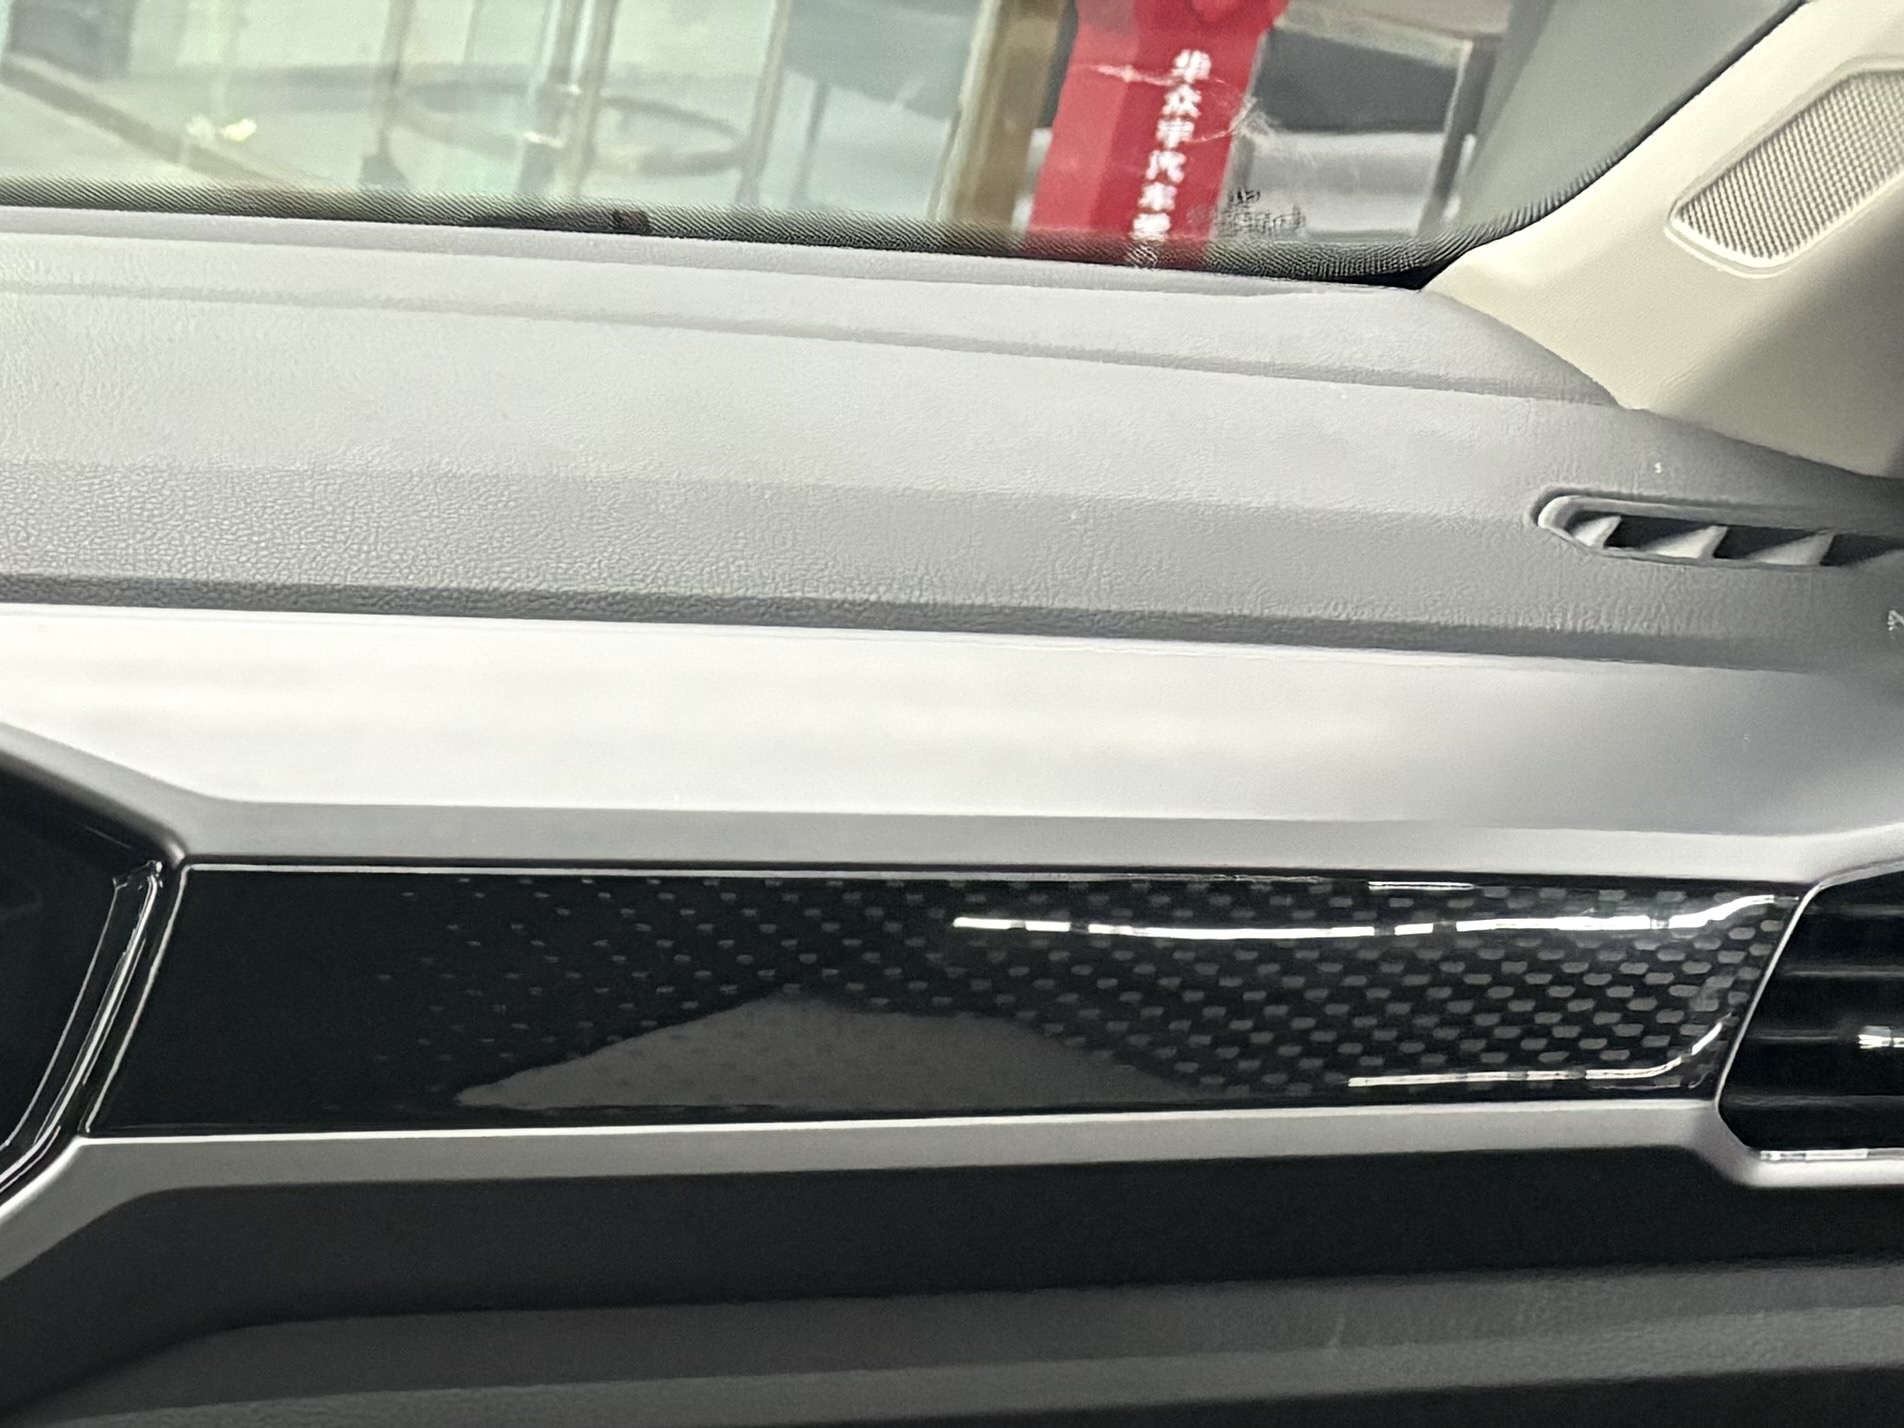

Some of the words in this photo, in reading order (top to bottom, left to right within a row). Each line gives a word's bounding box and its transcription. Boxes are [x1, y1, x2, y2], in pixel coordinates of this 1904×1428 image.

[1127, 48, 1212, 268] 华众宇汽车
